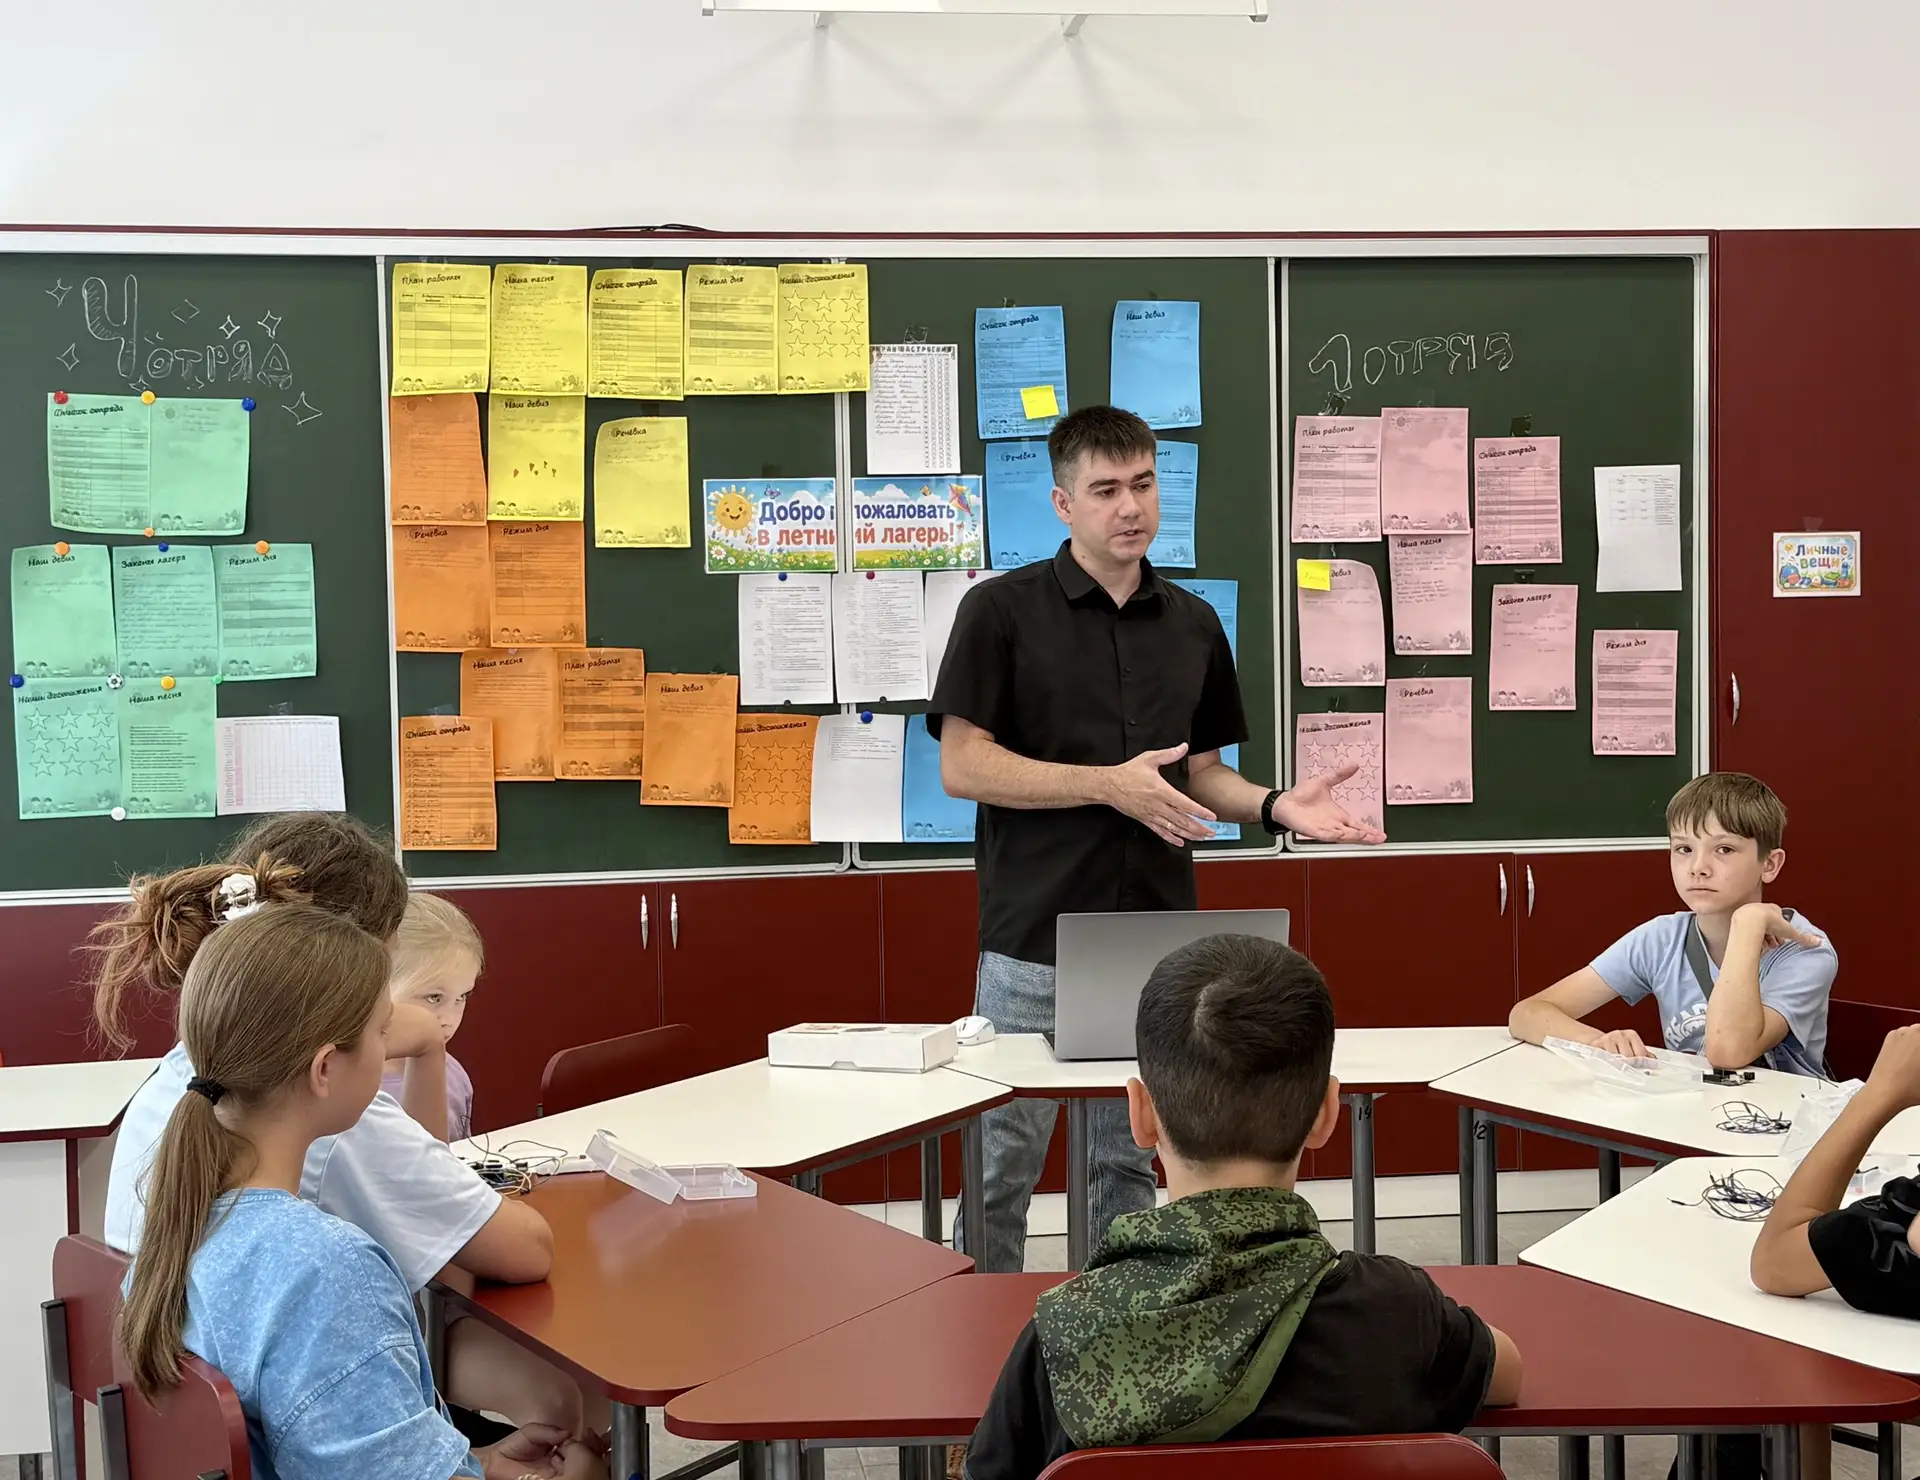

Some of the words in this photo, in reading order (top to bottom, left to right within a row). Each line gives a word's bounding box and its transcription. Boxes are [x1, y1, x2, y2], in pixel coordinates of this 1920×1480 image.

[402, 276, 424, 285] План
[427, 273, 461, 285] работы
[503, 275, 529, 286] Наша
[531, 274, 555, 284] песня
[595, 280, 625, 292] Список
[627, 278, 659, 290] отряда
[698, 276, 726, 286] Режим
[727, 275, 745, 284] дня
[780, 276, 803, 286] Наши
[804, 271, 856, 285] достижения
[980, 321, 1007, 331] Список
[1009, 314, 1040, 327] отряда
[1126, 312, 1142, 321] Наш
[1144, 311, 1166, 321] девиз
[1308, 333, 1353, 394] 1
[54, 406, 87, 417] Список
[89, 404, 124, 415] отряда
[505, 401, 524, 410] Наш
[526, 399, 550, 409] девиз
[1302, 429, 1321, 438] План
[1323, 426, 1356, 437] работы
[1479, 451, 1506, 461] Список
[1507, 445, 1537, 457] отряда
[759, 499, 825, 526] Добро
[503, 527, 534, 538] Режим
[535, 524, 550, 533] дня
[757, 531, 770, 546] в
[881, 522, 956, 548] лагерь!
[1397, 539, 1419, 549] Наша
[1421, 537, 1443, 547] песня
[1795, 544, 1848, 556] Личные
[28, 558, 48, 568] Наш
[51, 554, 77, 566] девиз
[121, 558, 155, 569] Законы
[157, 555, 187, 567] лагеря
[228, 556, 260, 568] Режим
[262, 553, 278, 563] дня
[1800, 557, 1840, 569] вещи
[1331, 568, 1351, 578] девиз
[1498, 596, 1525, 607] Законы
[1527, 593, 1553, 604] лагеря
[1605, 641, 1630, 651] Режим
[1633, 640, 1648, 648] дня
[473, 661, 498, 670] Наша
[500, 657, 523, 668] песня
[565, 662, 584, 671] План
[587, 658, 621, 671] работы
[18, 694, 46, 705] Наши
[47, 686, 103, 702] достижения
[660, 684, 679, 694] Наш
[681, 684, 704, 693] девиз
[129, 695, 155, 705] Наша
[157, 691, 182, 702] песня
[406, 728, 437, 740] Список
[439, 725, 471, 736] отряда
[756, 720, 808, 734] достижения
[1300, 723, 1322, 733] Наши
[1324, 719, 1371, 733] достижения
[1473, 1120, 1488, 1140] 12
